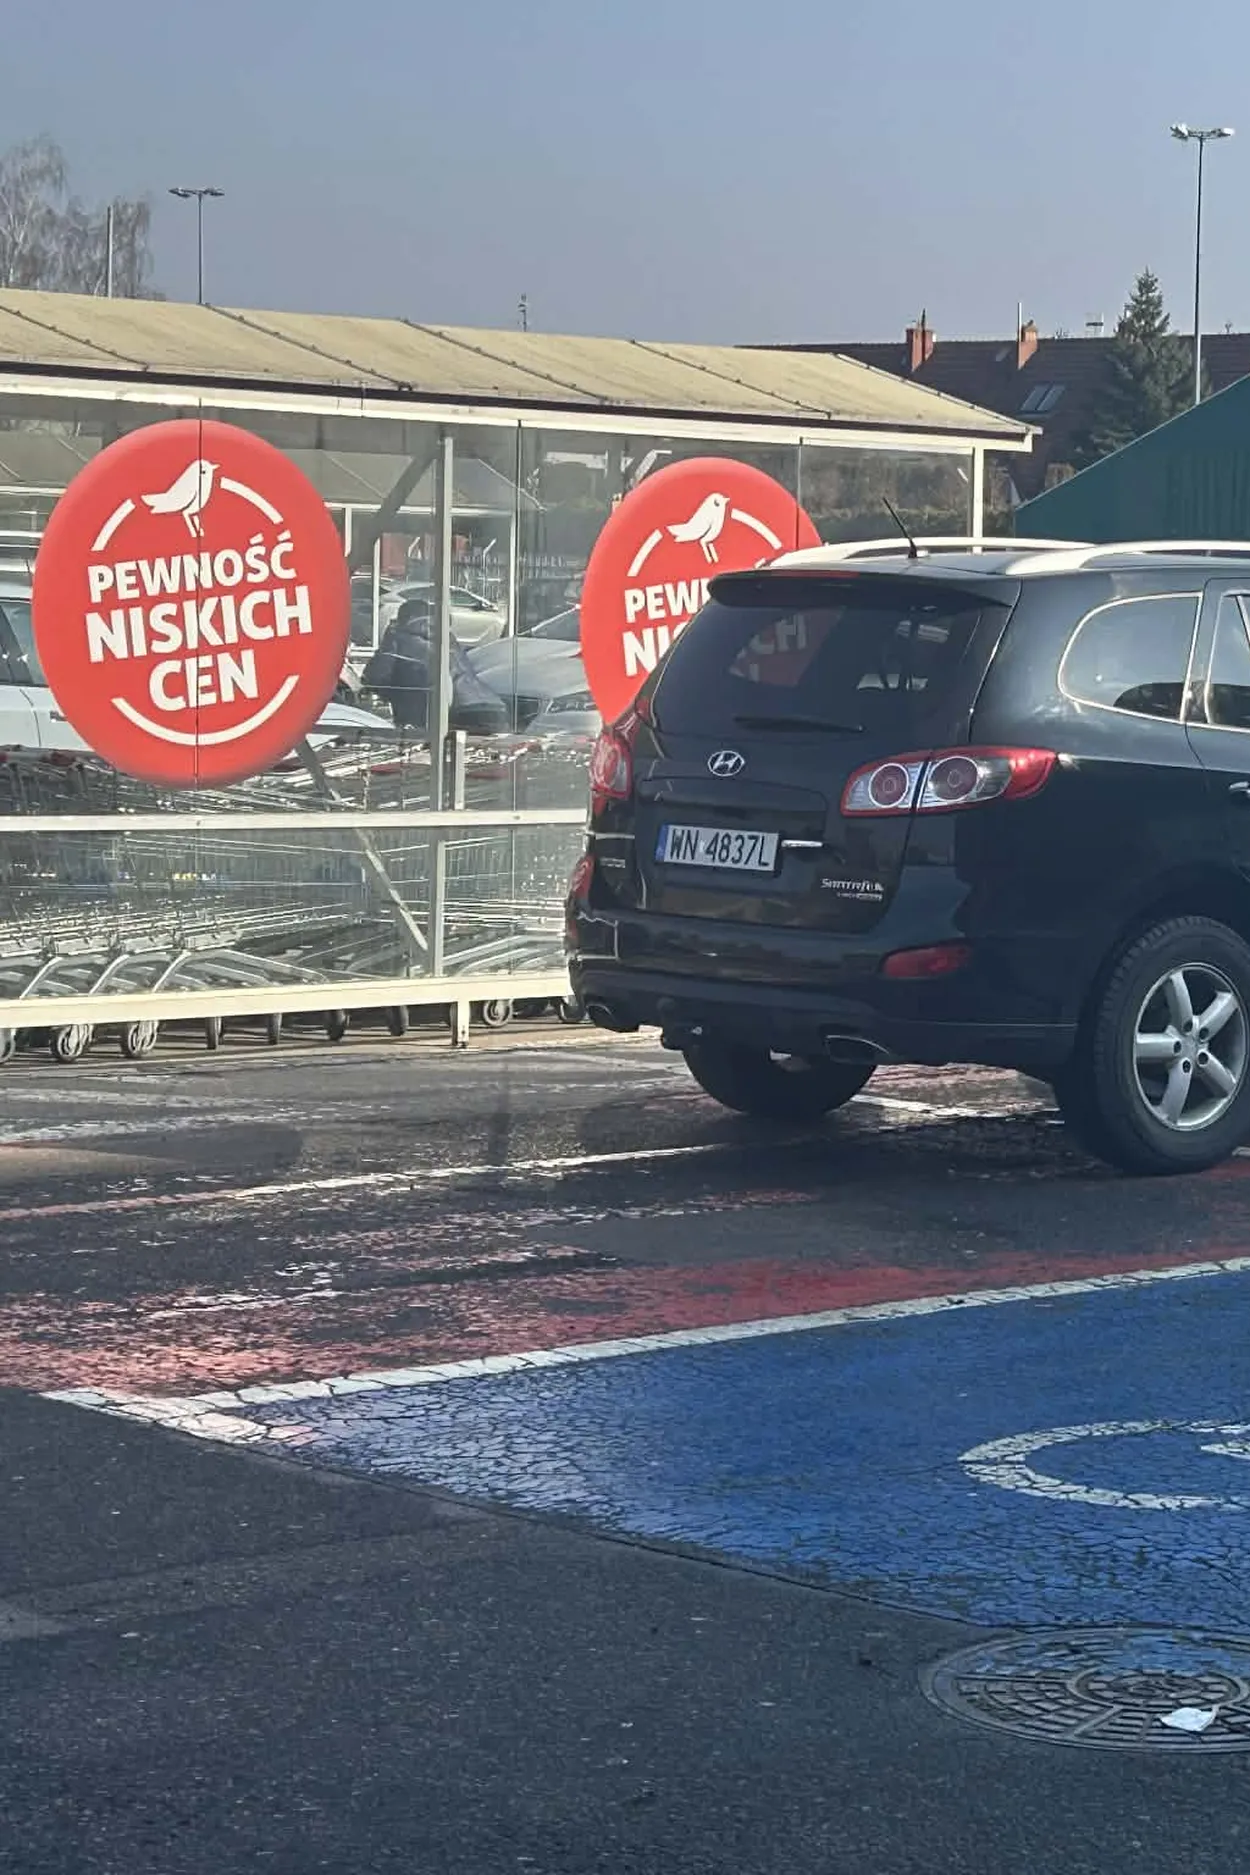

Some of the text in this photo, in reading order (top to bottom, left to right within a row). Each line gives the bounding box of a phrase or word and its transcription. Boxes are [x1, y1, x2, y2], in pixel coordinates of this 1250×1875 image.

[87, 530, 297, 603] PEWNOŚĆ
[85, 585, 313, 663] NISKICH
[149, 649, 259, 711] CEN
[669, 828, 770, 867] WN 4837L
